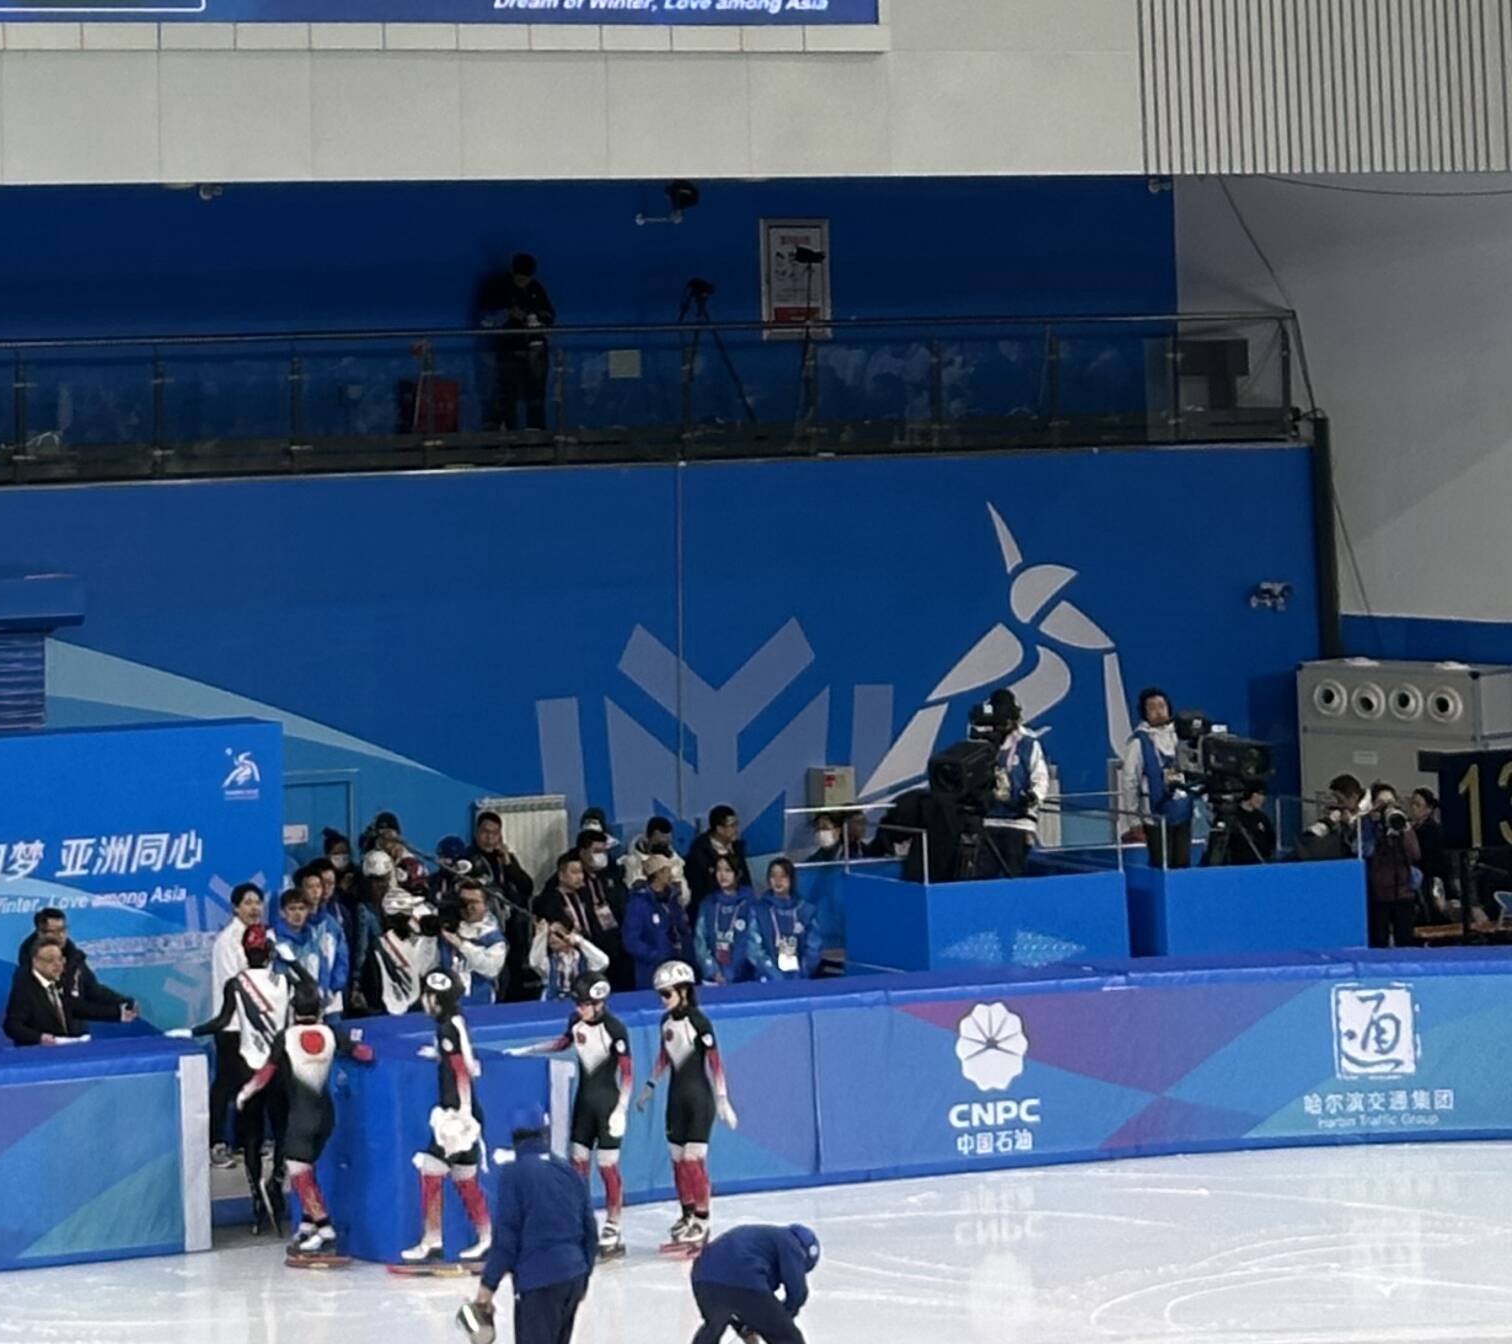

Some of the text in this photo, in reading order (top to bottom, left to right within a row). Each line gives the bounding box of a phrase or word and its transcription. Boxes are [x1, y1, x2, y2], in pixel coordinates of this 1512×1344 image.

[55, 829, 203, 878] 亚洲同心
[48, 893, 88, 909] Love
[91, 890, 146, 908] among
[150, 885, 187, 903] Asia
[949, 1098, 1041, 1128] CNPC
[1303, 1088, 1454, 1115] 哈尔滨交通集团
[956, 1129, 1033, 1155] 中国石油
